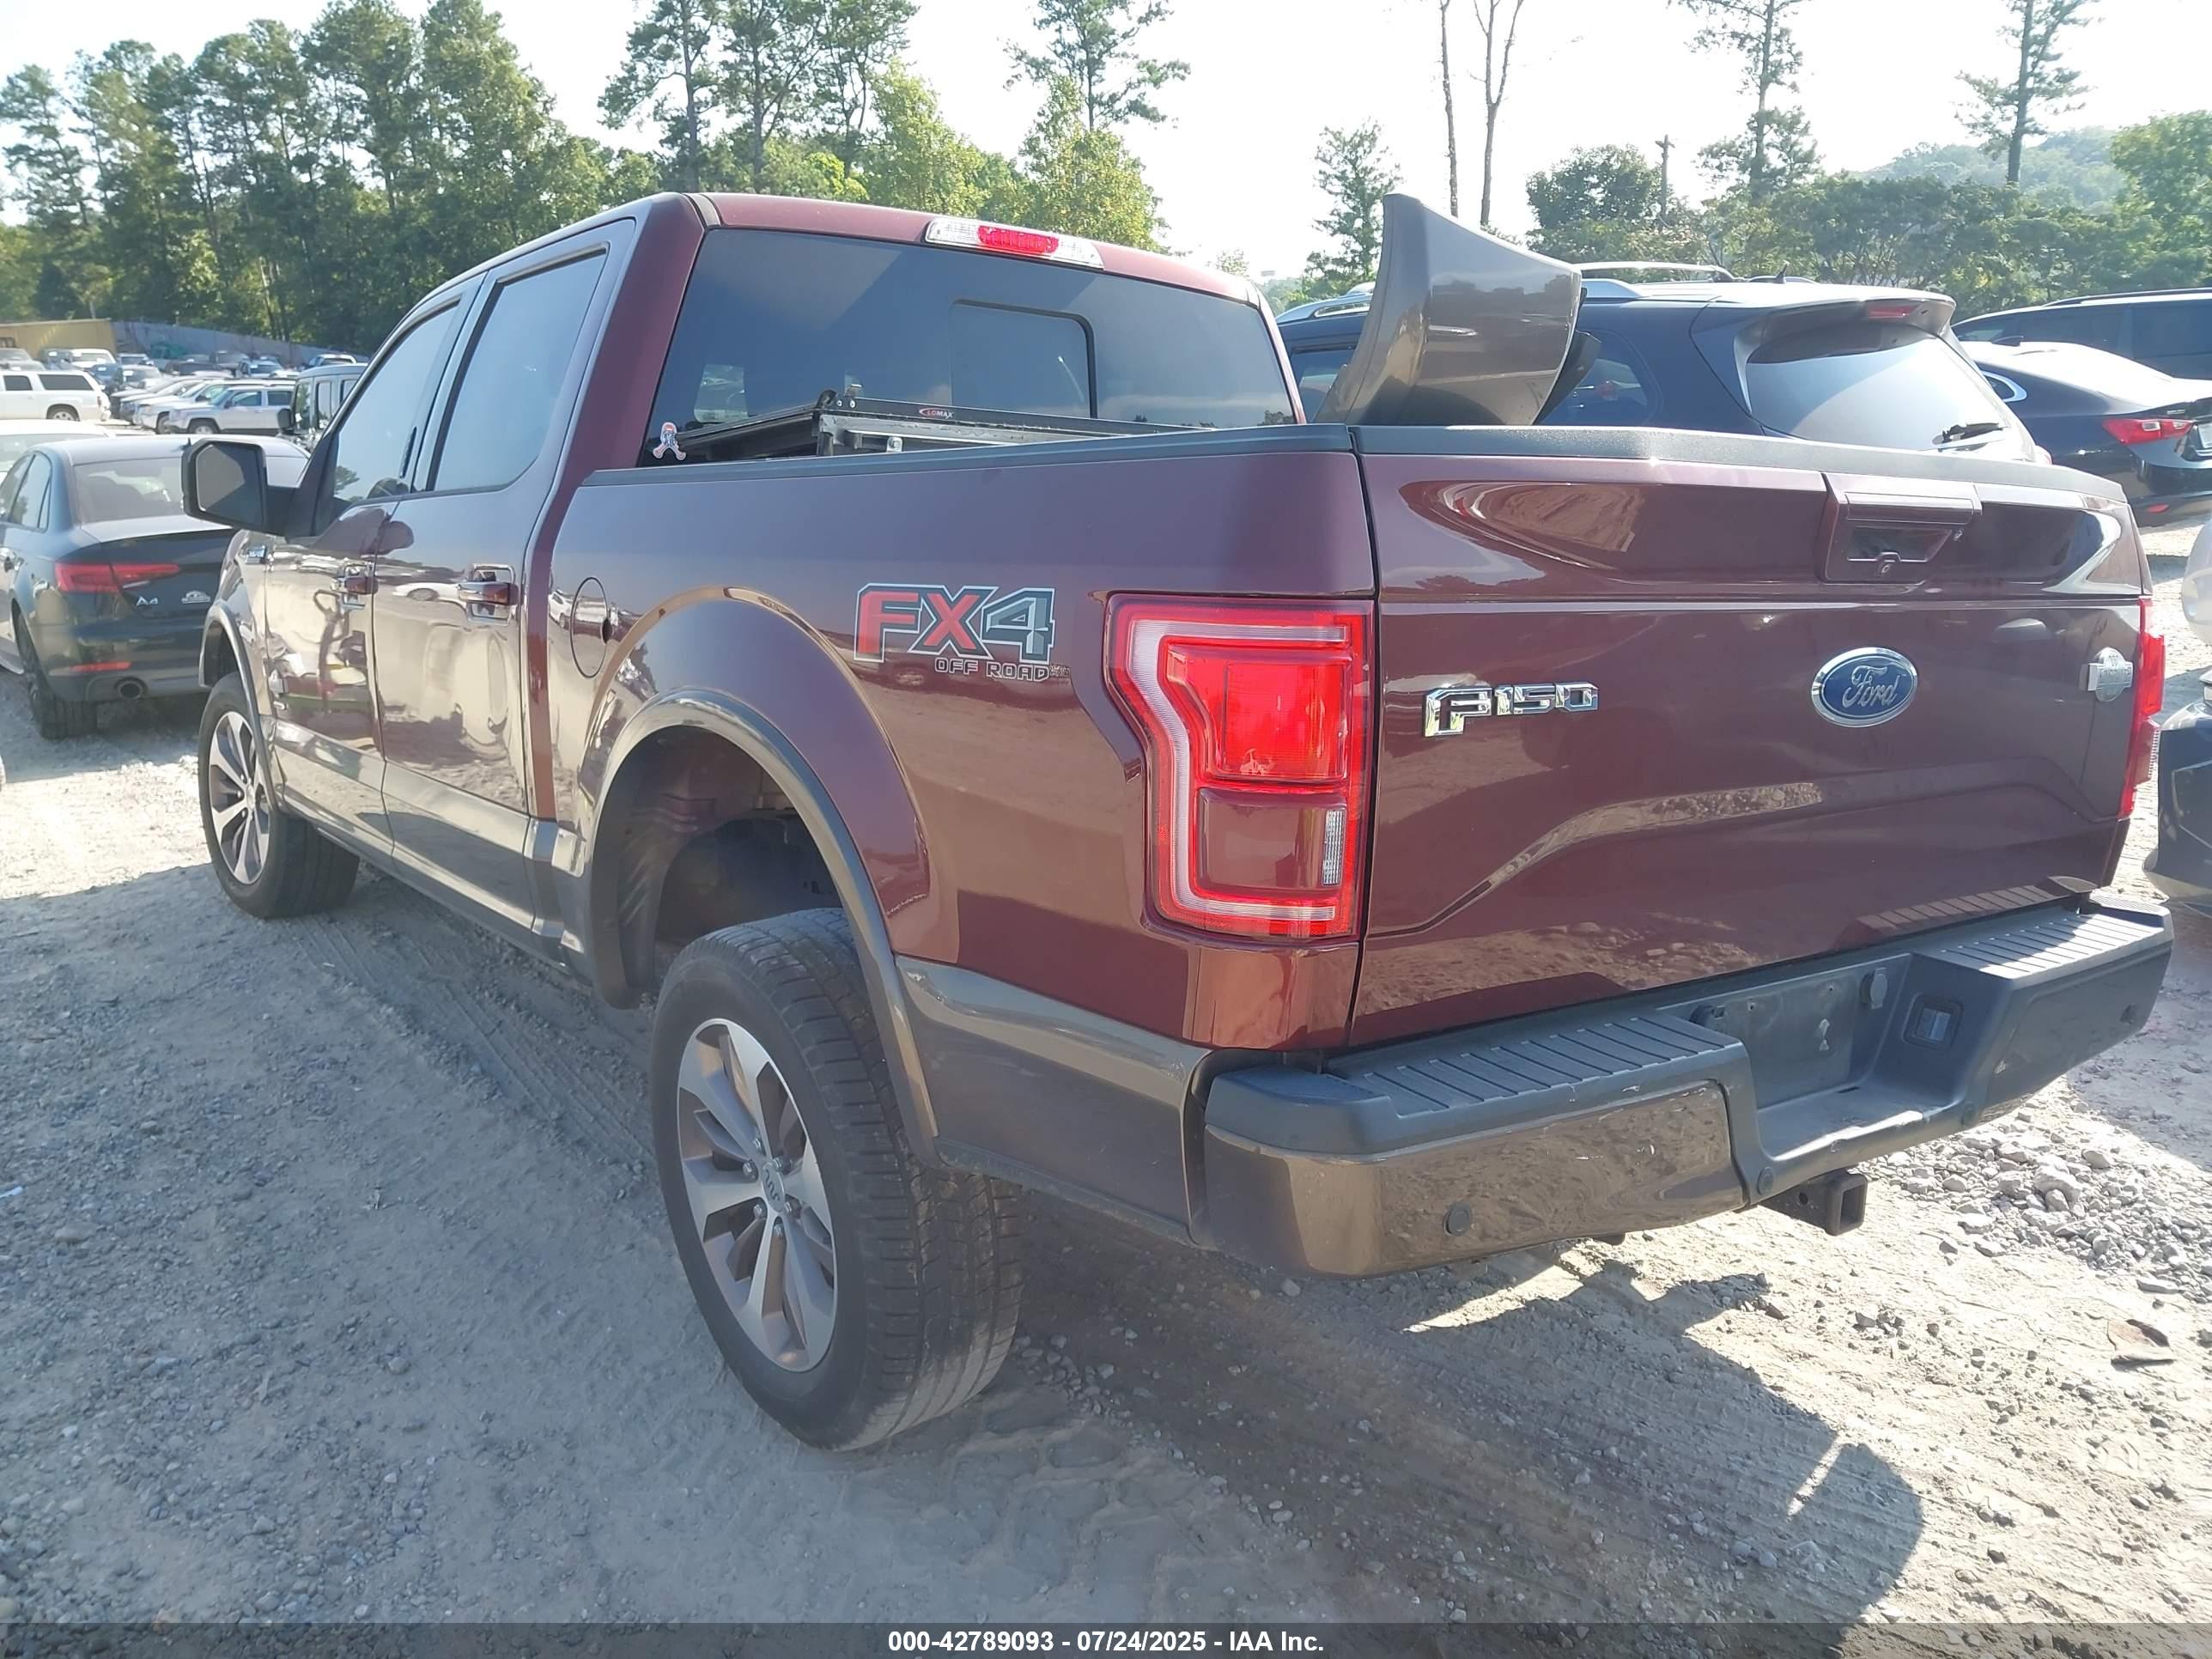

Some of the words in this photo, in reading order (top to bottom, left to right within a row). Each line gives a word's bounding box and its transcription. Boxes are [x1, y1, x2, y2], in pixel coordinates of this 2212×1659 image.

[137, 596, 158, 606] A4
[854, 583, 1055, 665] FX4
[935, 658, 978, 674] OFF
[987, 662, 1050, 682] ROAD
[1842, 665, 1901, 708] Ford
